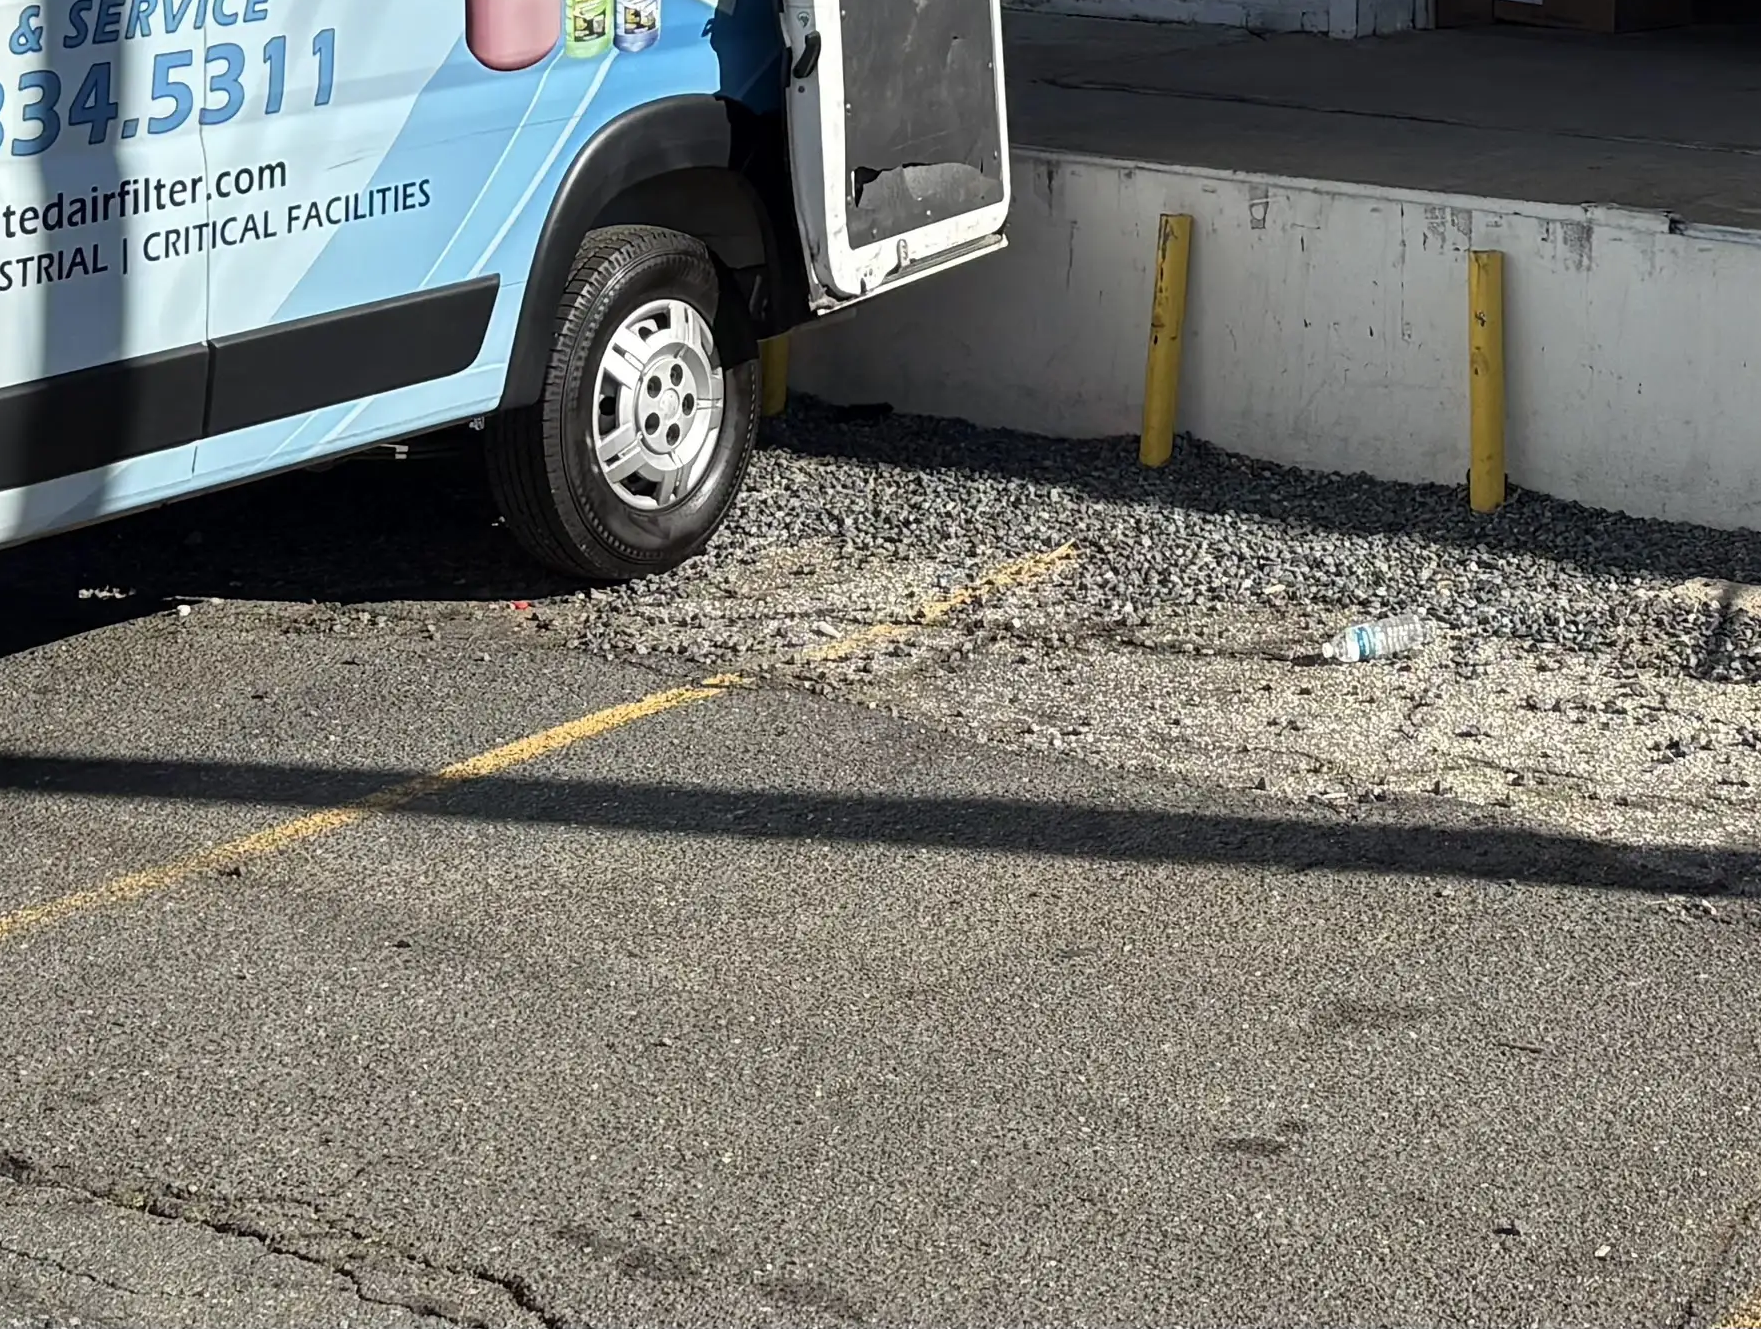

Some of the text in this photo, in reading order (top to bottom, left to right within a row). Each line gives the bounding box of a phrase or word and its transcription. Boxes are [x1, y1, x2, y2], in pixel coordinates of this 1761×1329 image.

[7, 4, 42, 56] &
[142, 209, 278, 262] CRITICAL
[287, 178, 431, 235] FACILITIES
